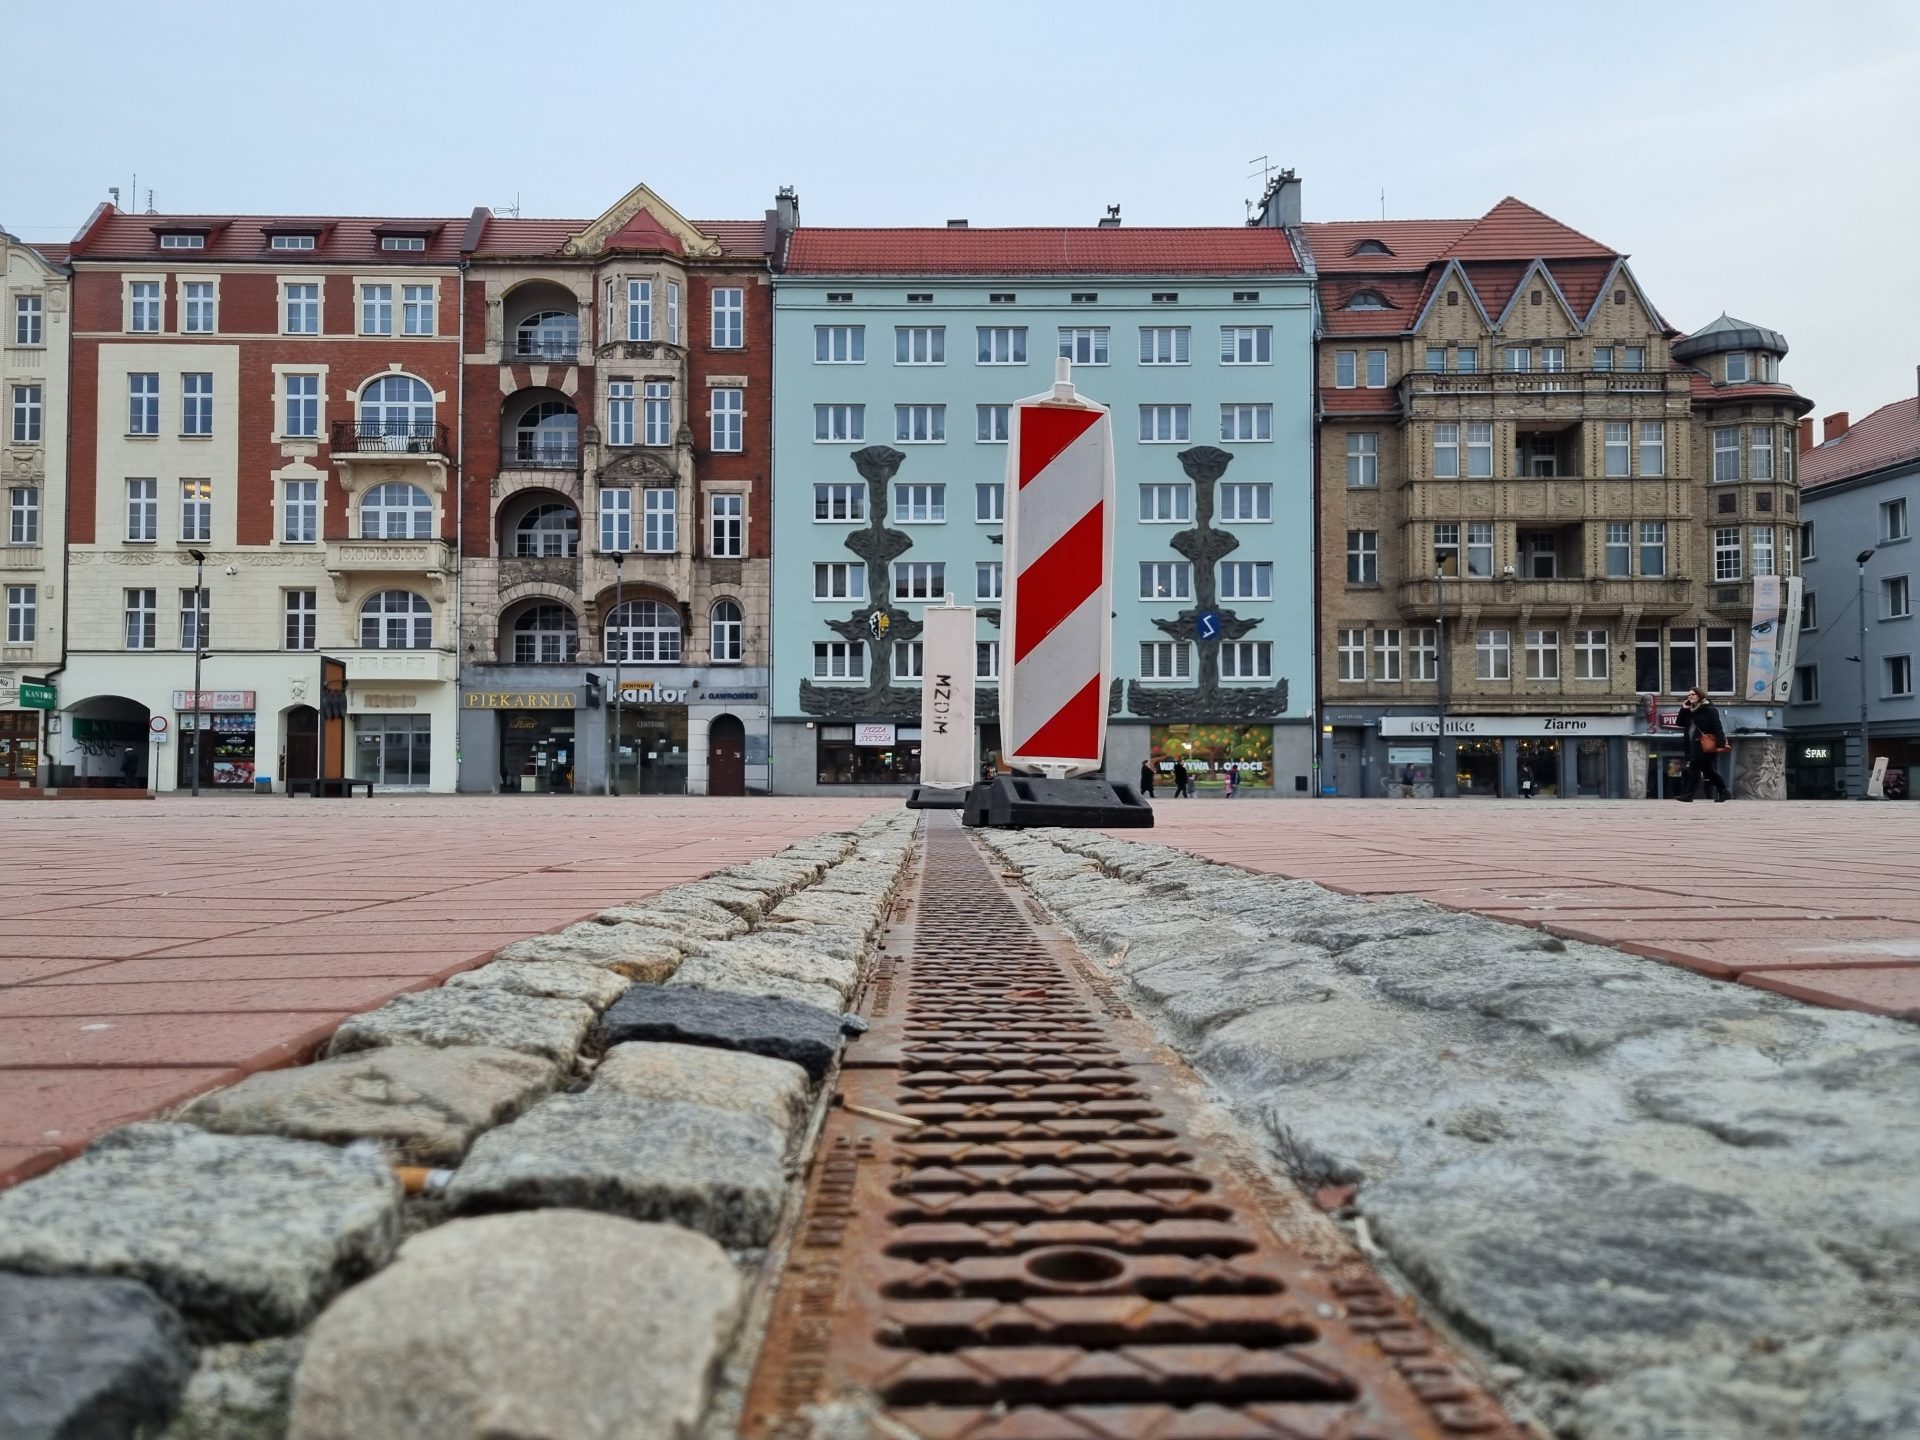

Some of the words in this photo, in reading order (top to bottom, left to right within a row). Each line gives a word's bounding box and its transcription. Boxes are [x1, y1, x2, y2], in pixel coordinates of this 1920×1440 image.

[25, 690, 53, 700] KANTOR
[606, 680, 687, 703] kantor
[470, 694, 571, 706] PIEKARNIA
[1544, 718, 1587, 730] Ziarno
[1159, 761, 1210, 771] WAYWA
